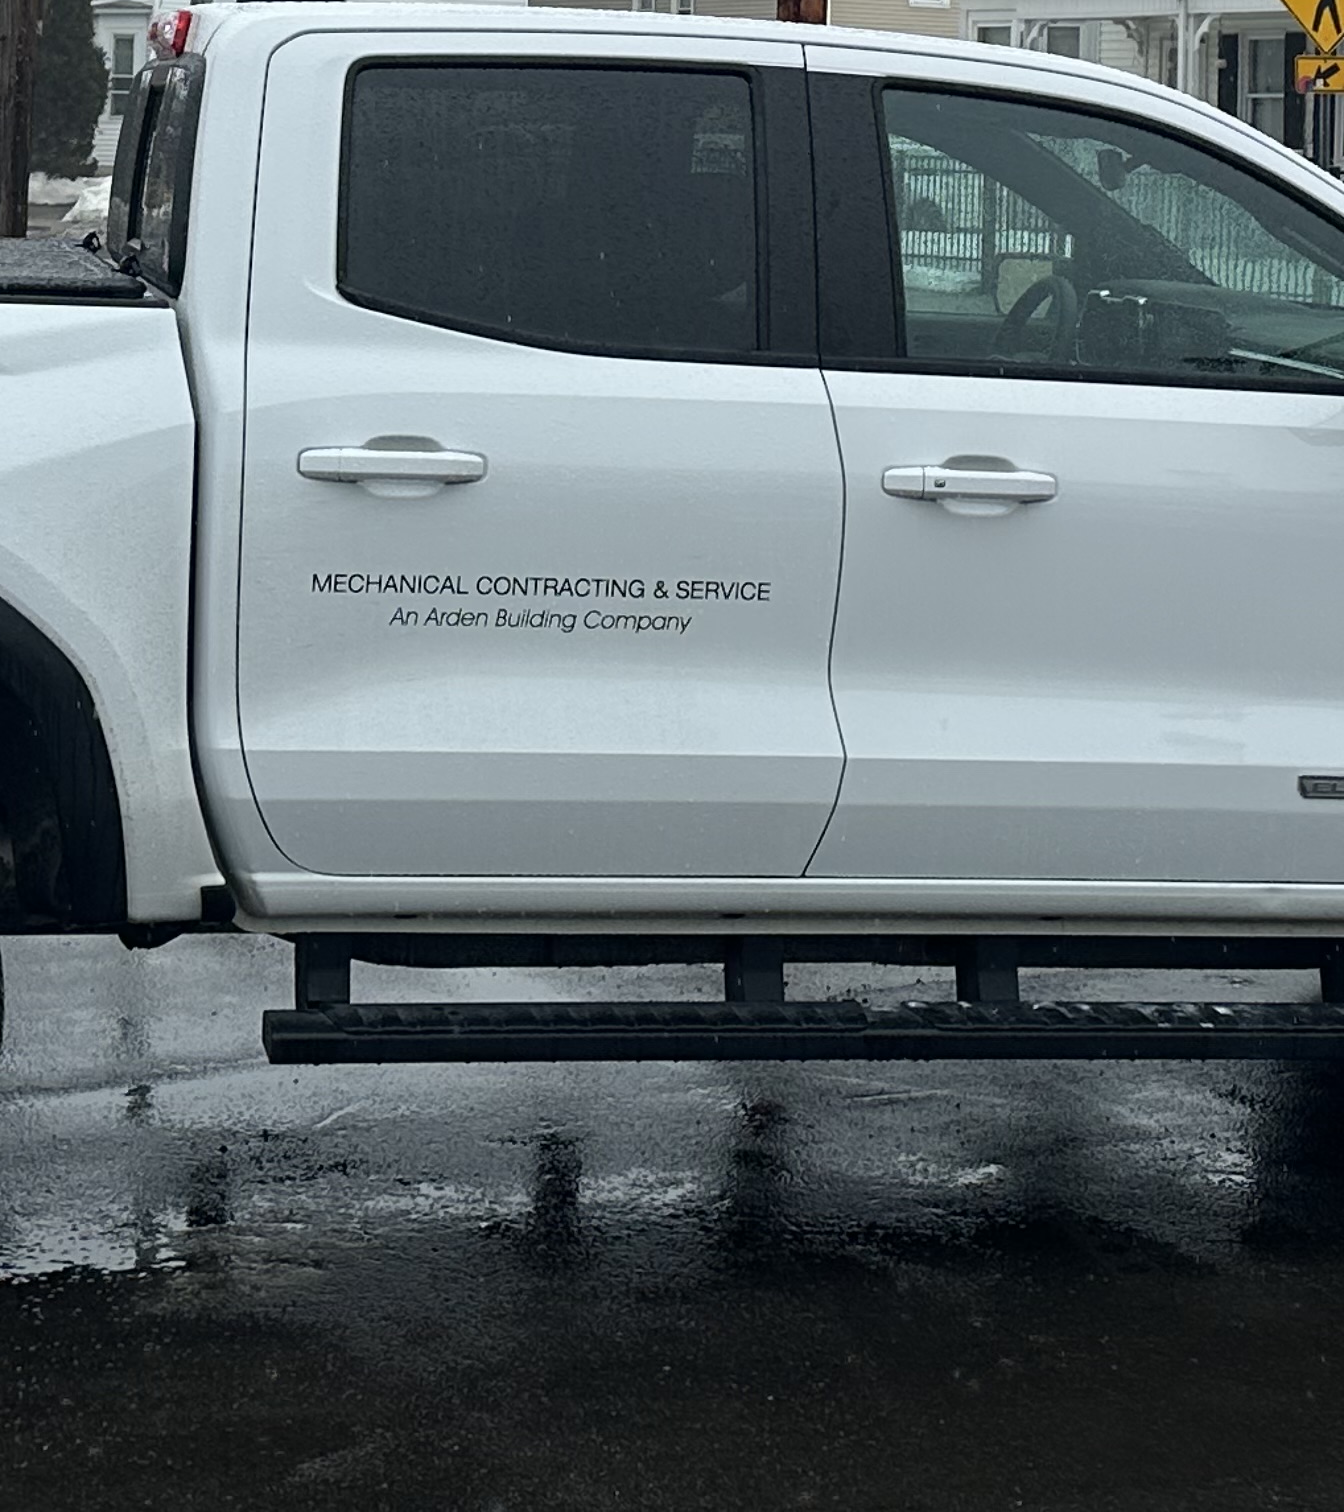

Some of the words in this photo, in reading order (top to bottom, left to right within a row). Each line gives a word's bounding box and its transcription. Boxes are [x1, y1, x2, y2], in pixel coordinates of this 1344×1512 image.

[311, 573, 469, 595] MECHANICAL
[475, 575, 646, 599] CONTRACTING
[653, 580, 670, 599] &
[675, 580, 771, 601] SERVICE
[389, 606, 419, 627] An
[423, 606, 489, 628] Arden
[494, 607, 578, 634] Building
[582, 609, 693, 635] Company
